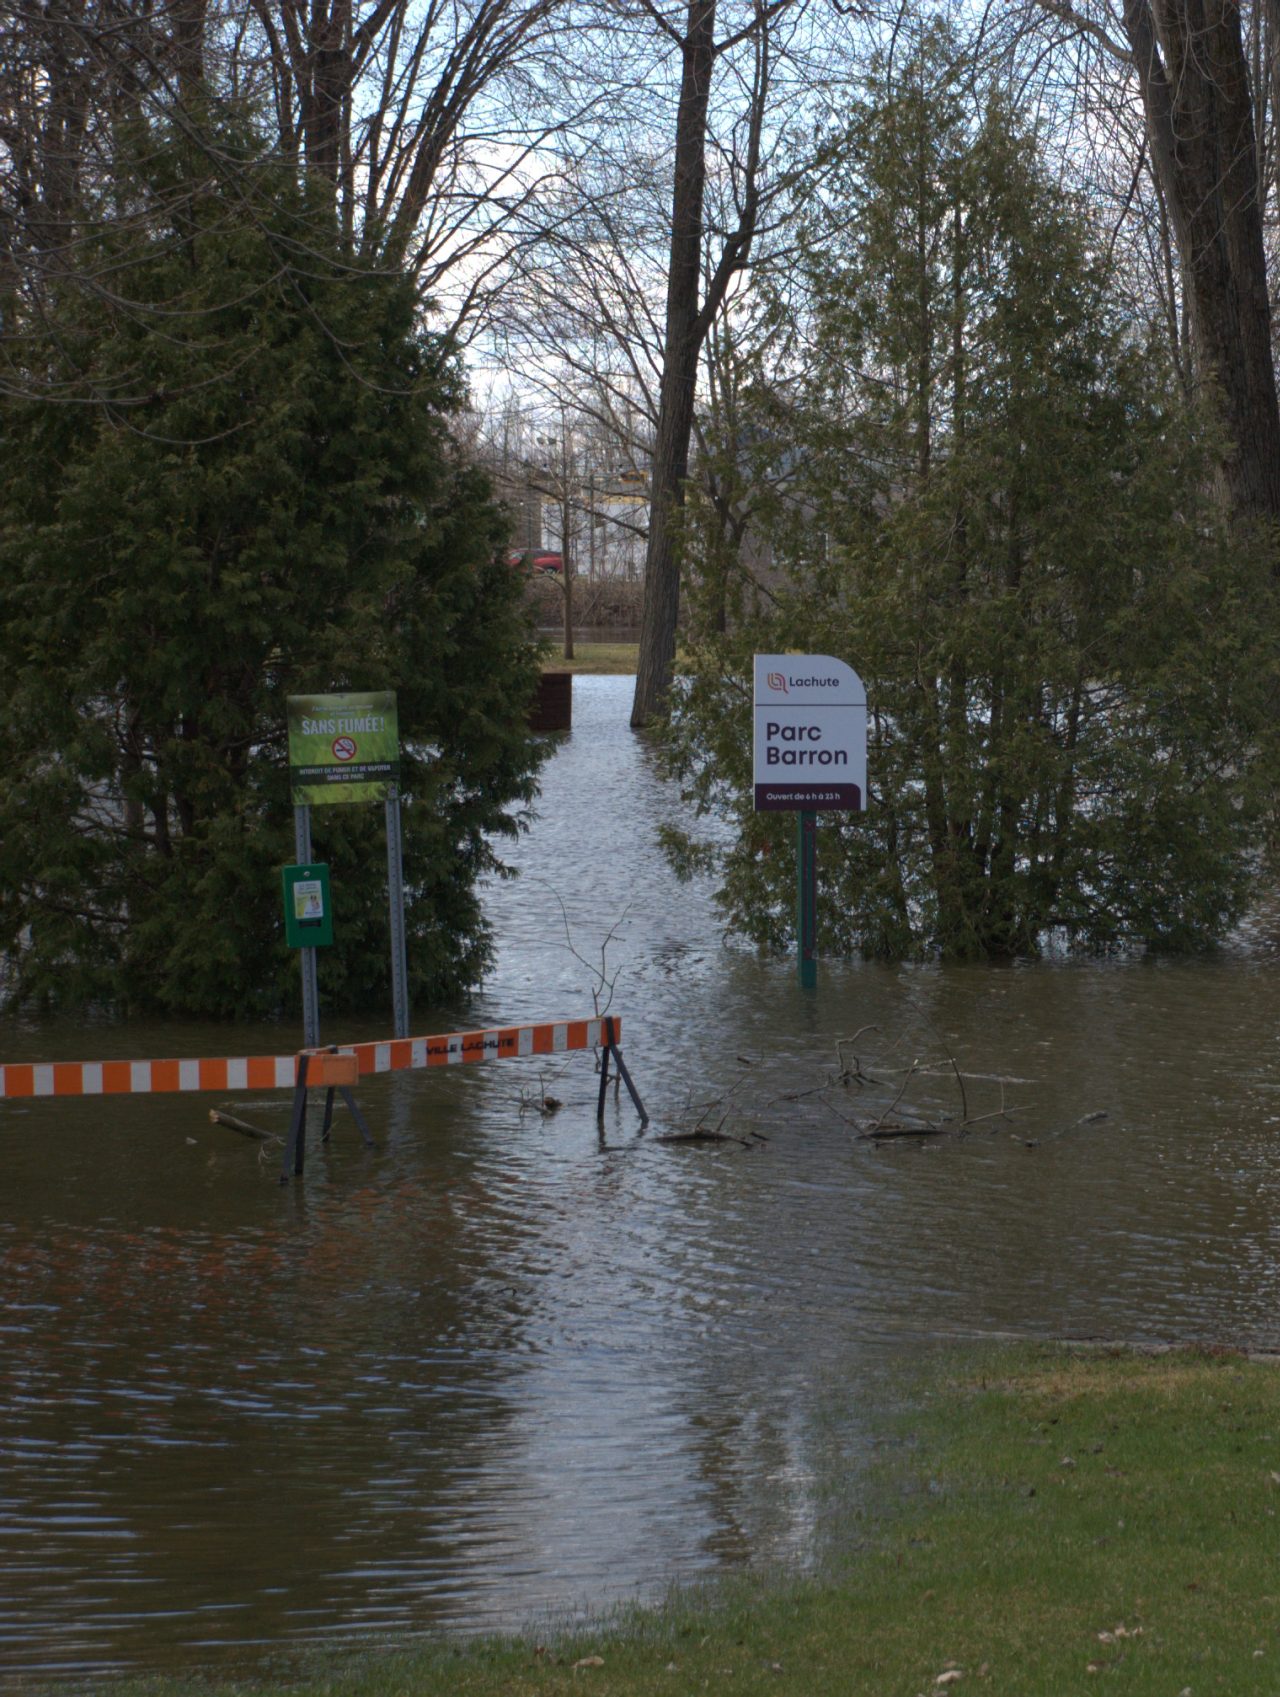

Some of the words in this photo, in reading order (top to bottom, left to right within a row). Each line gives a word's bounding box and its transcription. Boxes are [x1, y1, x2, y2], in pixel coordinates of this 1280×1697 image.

[789, 676, 840, 687] Lachute
[302, 719, 336, 735] SANS
[766, 722, 822, 741] Parc
[766, 747, 848, 765] Barron
[766, 792, 793, 800] Ouvert
[794, 792, 805, 800] de
[806, 792, 811, 800] 6
[812, 792, 817, 800] h
[818, 791, 824, 800] à
[835, 792, 841, 800] h
[426, 1044, 458, 1055] VILLE
[461, 1039, 513, 1051] LACHUTE
